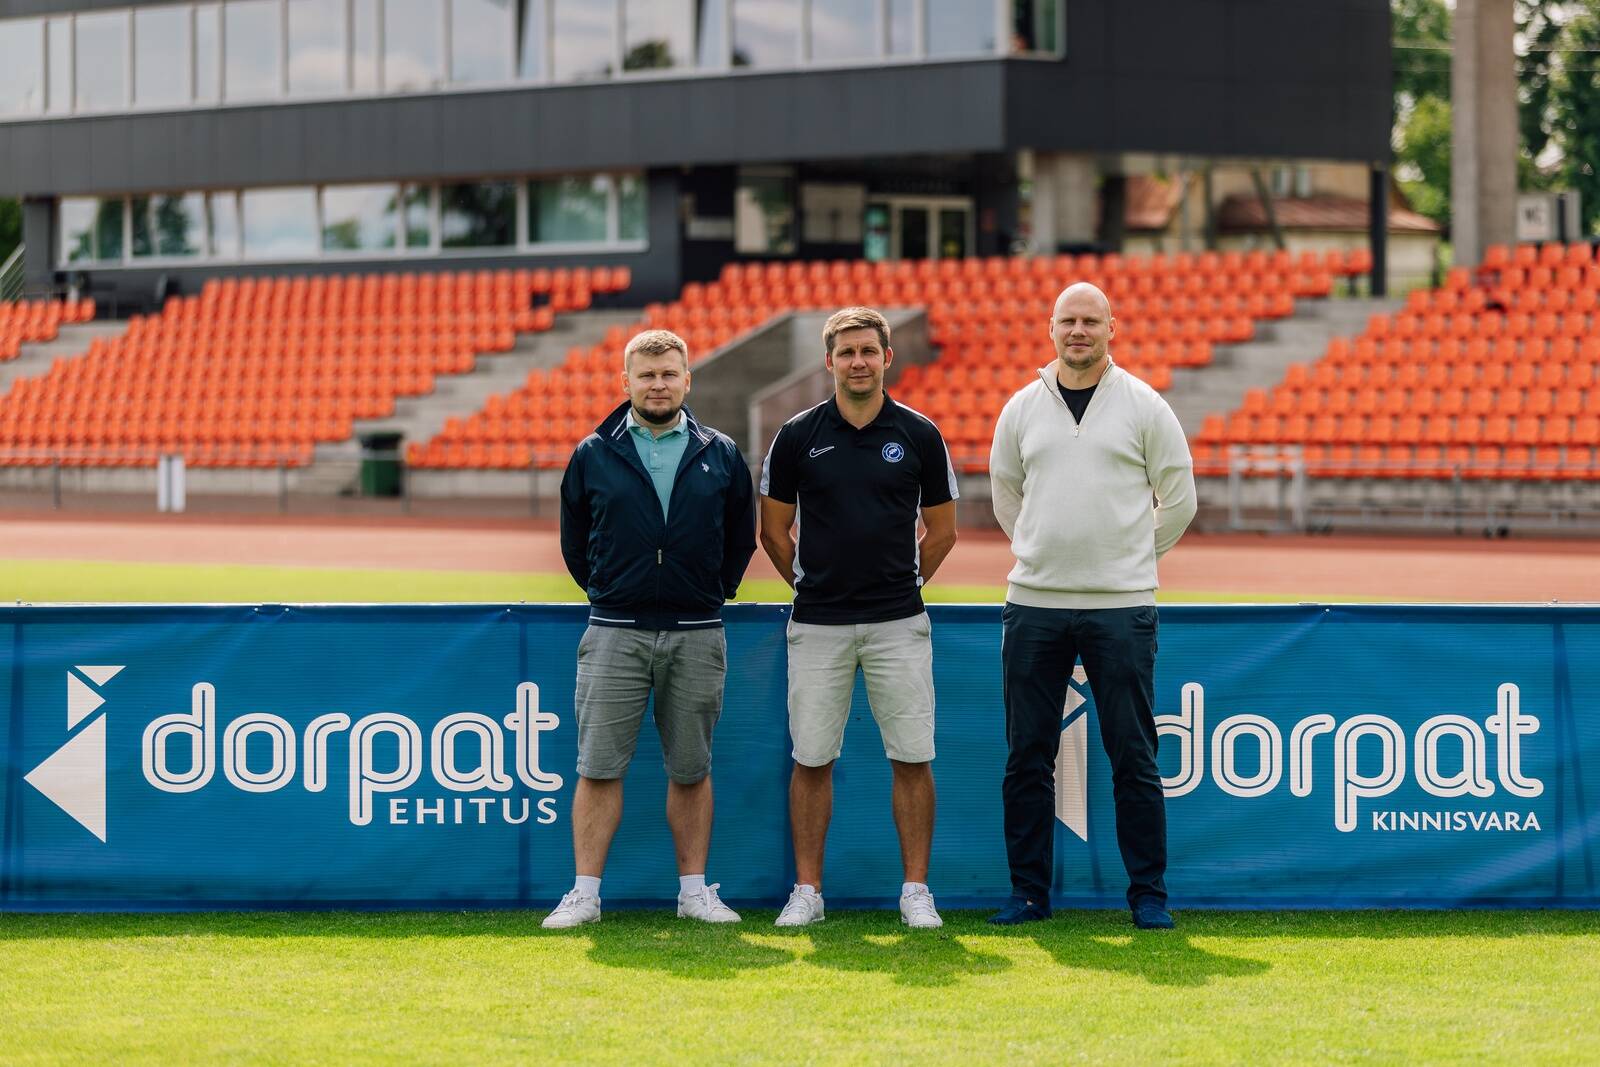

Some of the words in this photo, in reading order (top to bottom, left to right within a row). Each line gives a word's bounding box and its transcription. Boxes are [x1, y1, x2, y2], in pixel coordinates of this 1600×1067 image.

[142, 682, 563, 825] dorpat
[1153, 682, 1543, 832] dorpat
[389, 797, 558, 825] EHITUS
[1371, 811, 1541, 832] KINNISVARA
